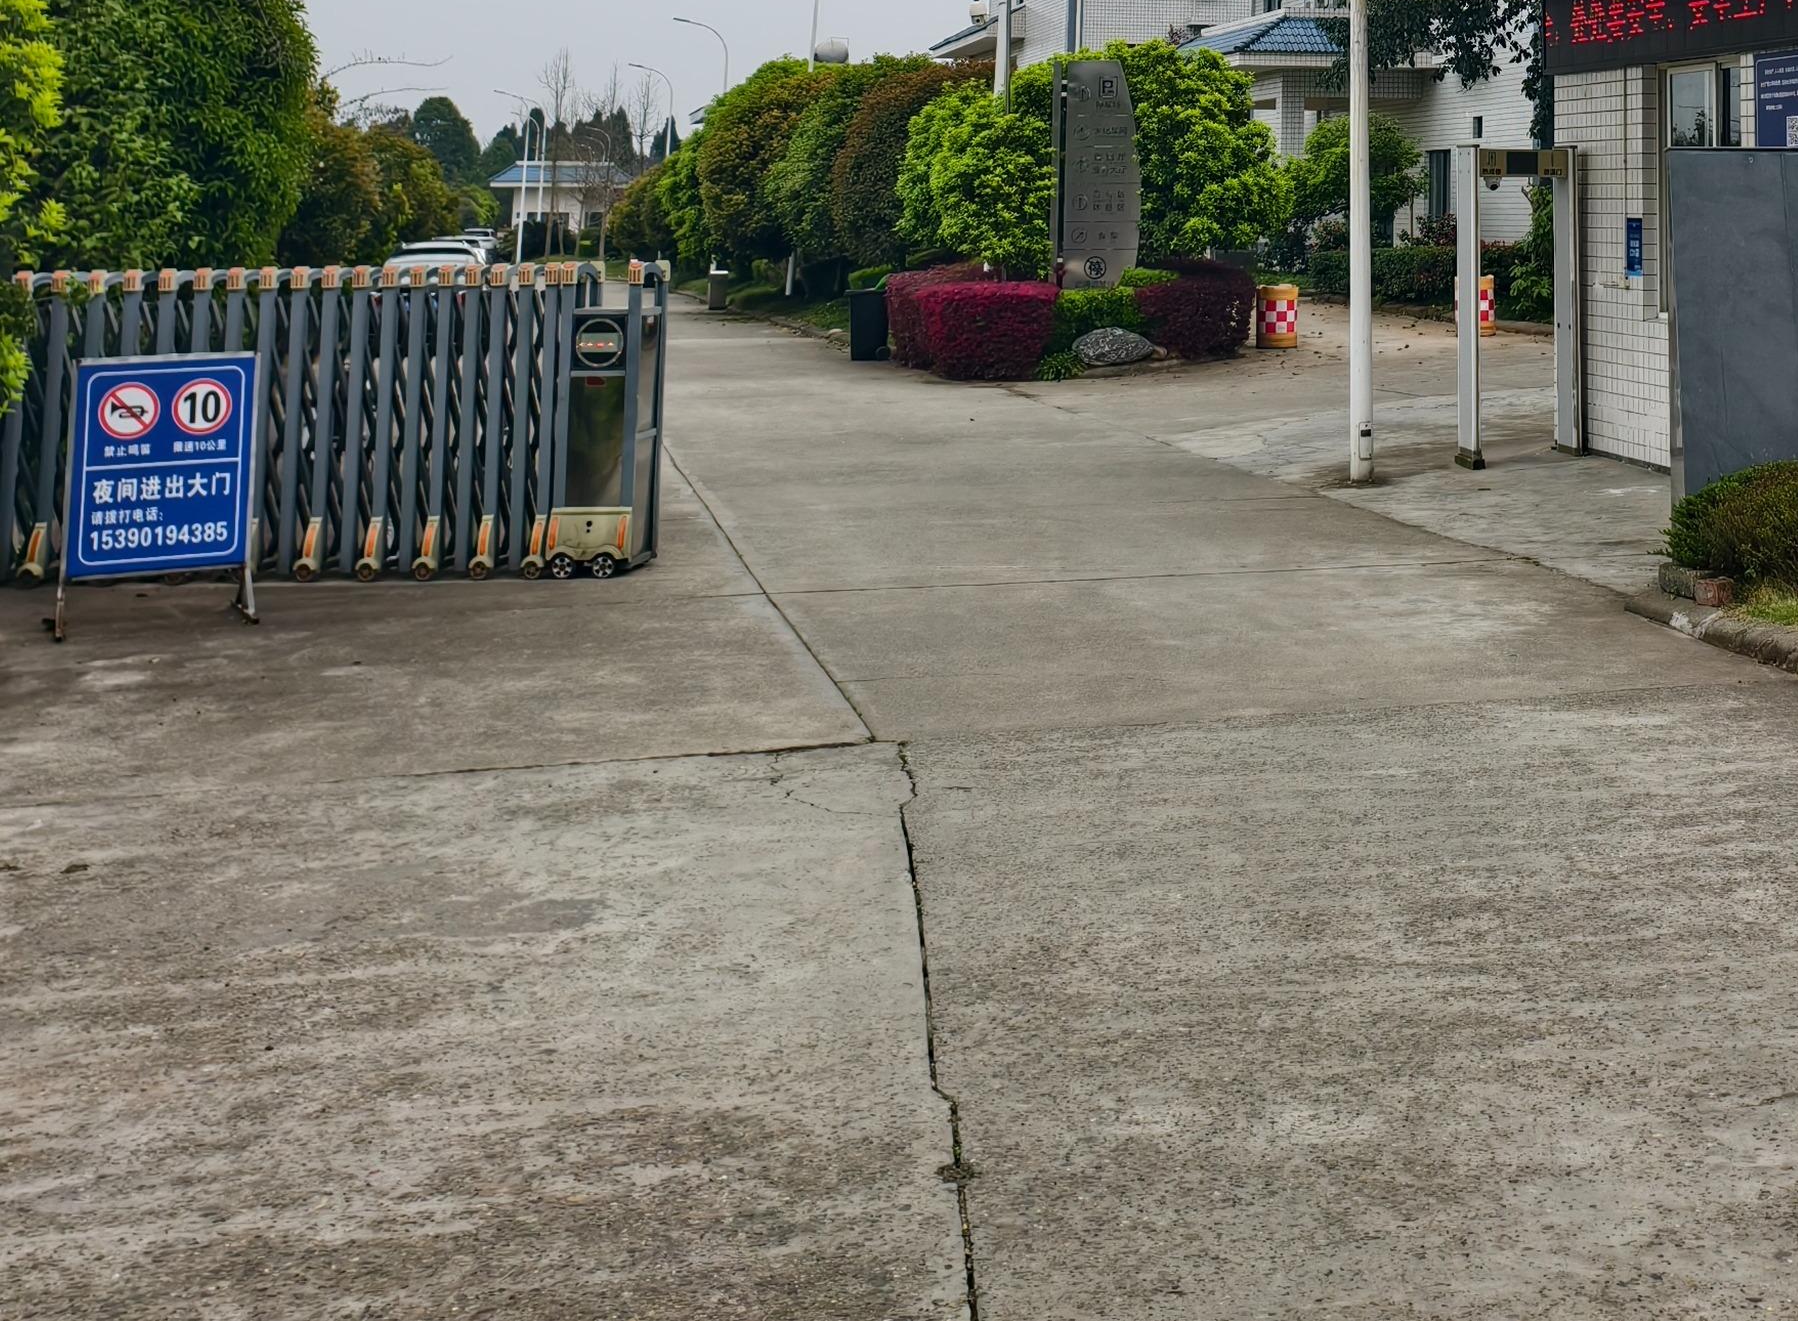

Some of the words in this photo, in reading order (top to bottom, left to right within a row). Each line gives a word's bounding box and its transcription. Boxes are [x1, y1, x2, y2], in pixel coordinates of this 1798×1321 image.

[184, 390, 221, 424] 10
[92, 472, 231, 505] 夜间进出大门
[90, 521, 228, 552] 15390194385
